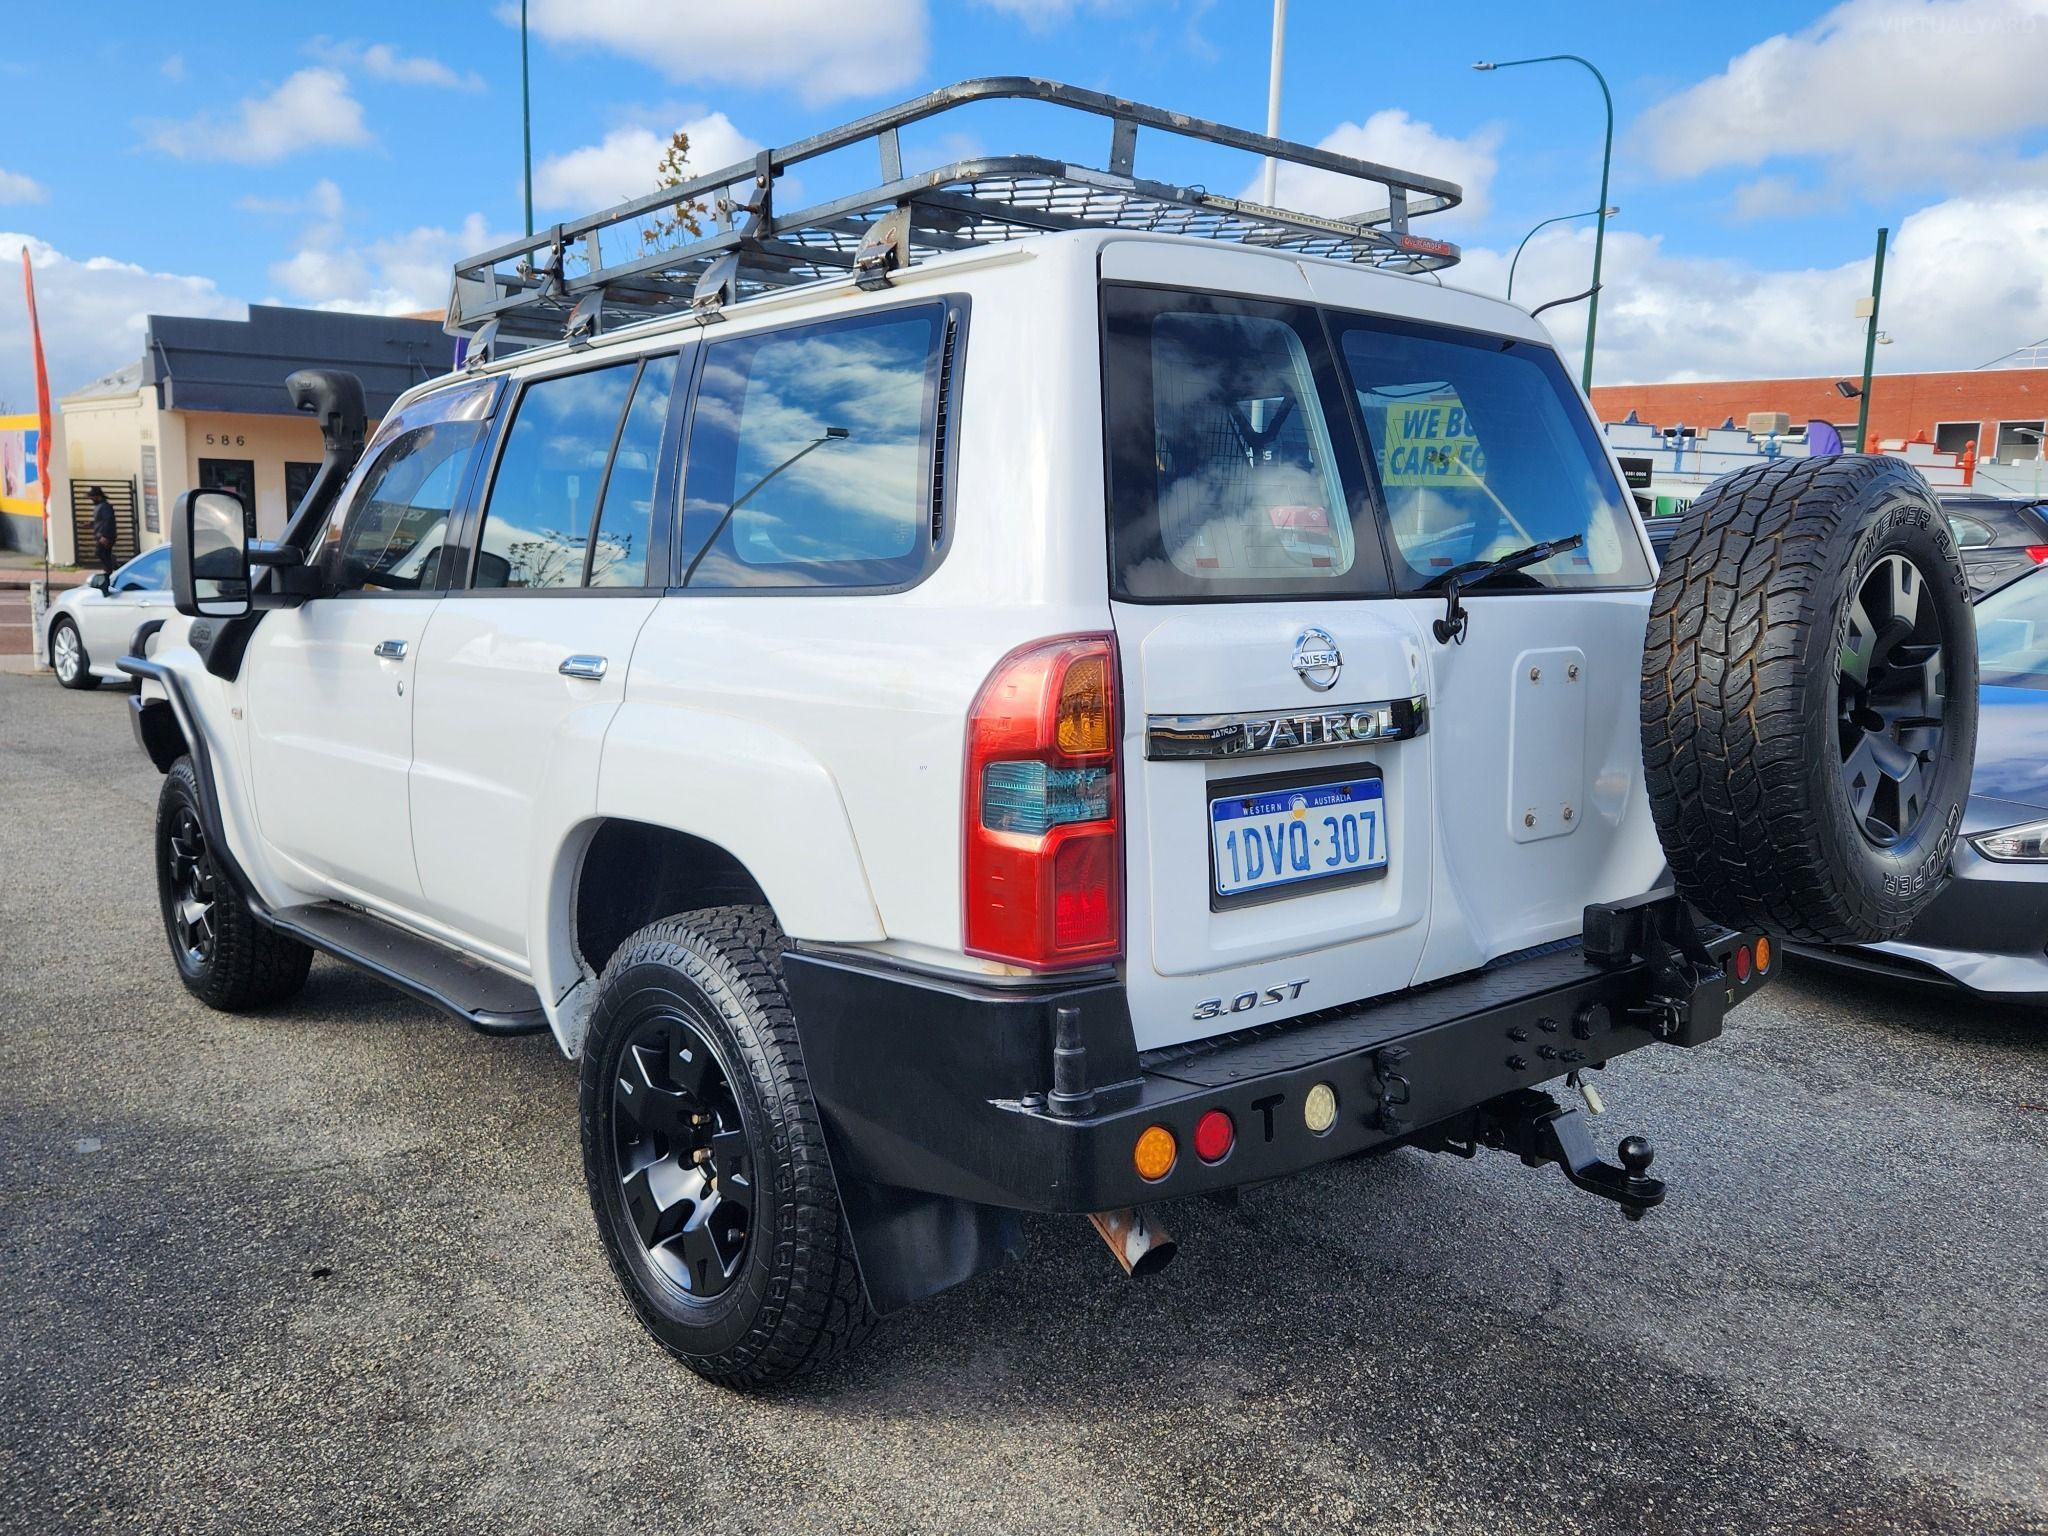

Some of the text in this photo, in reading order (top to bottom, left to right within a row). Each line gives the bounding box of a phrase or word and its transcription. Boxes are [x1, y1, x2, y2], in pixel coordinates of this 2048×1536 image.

[1403, 408, 1442, 439] WE
[206, 433, 245, 446] 586
[1391, 444, 1452, 475] CARS
[1300, 652, 1341, 666] NISSAN
[1242, 708, 1402, 751] PATROL
[1242, 793, 1352, 816] WESTERN AUSTRALIA
[1883, 803, 1961, 897] COOPER
